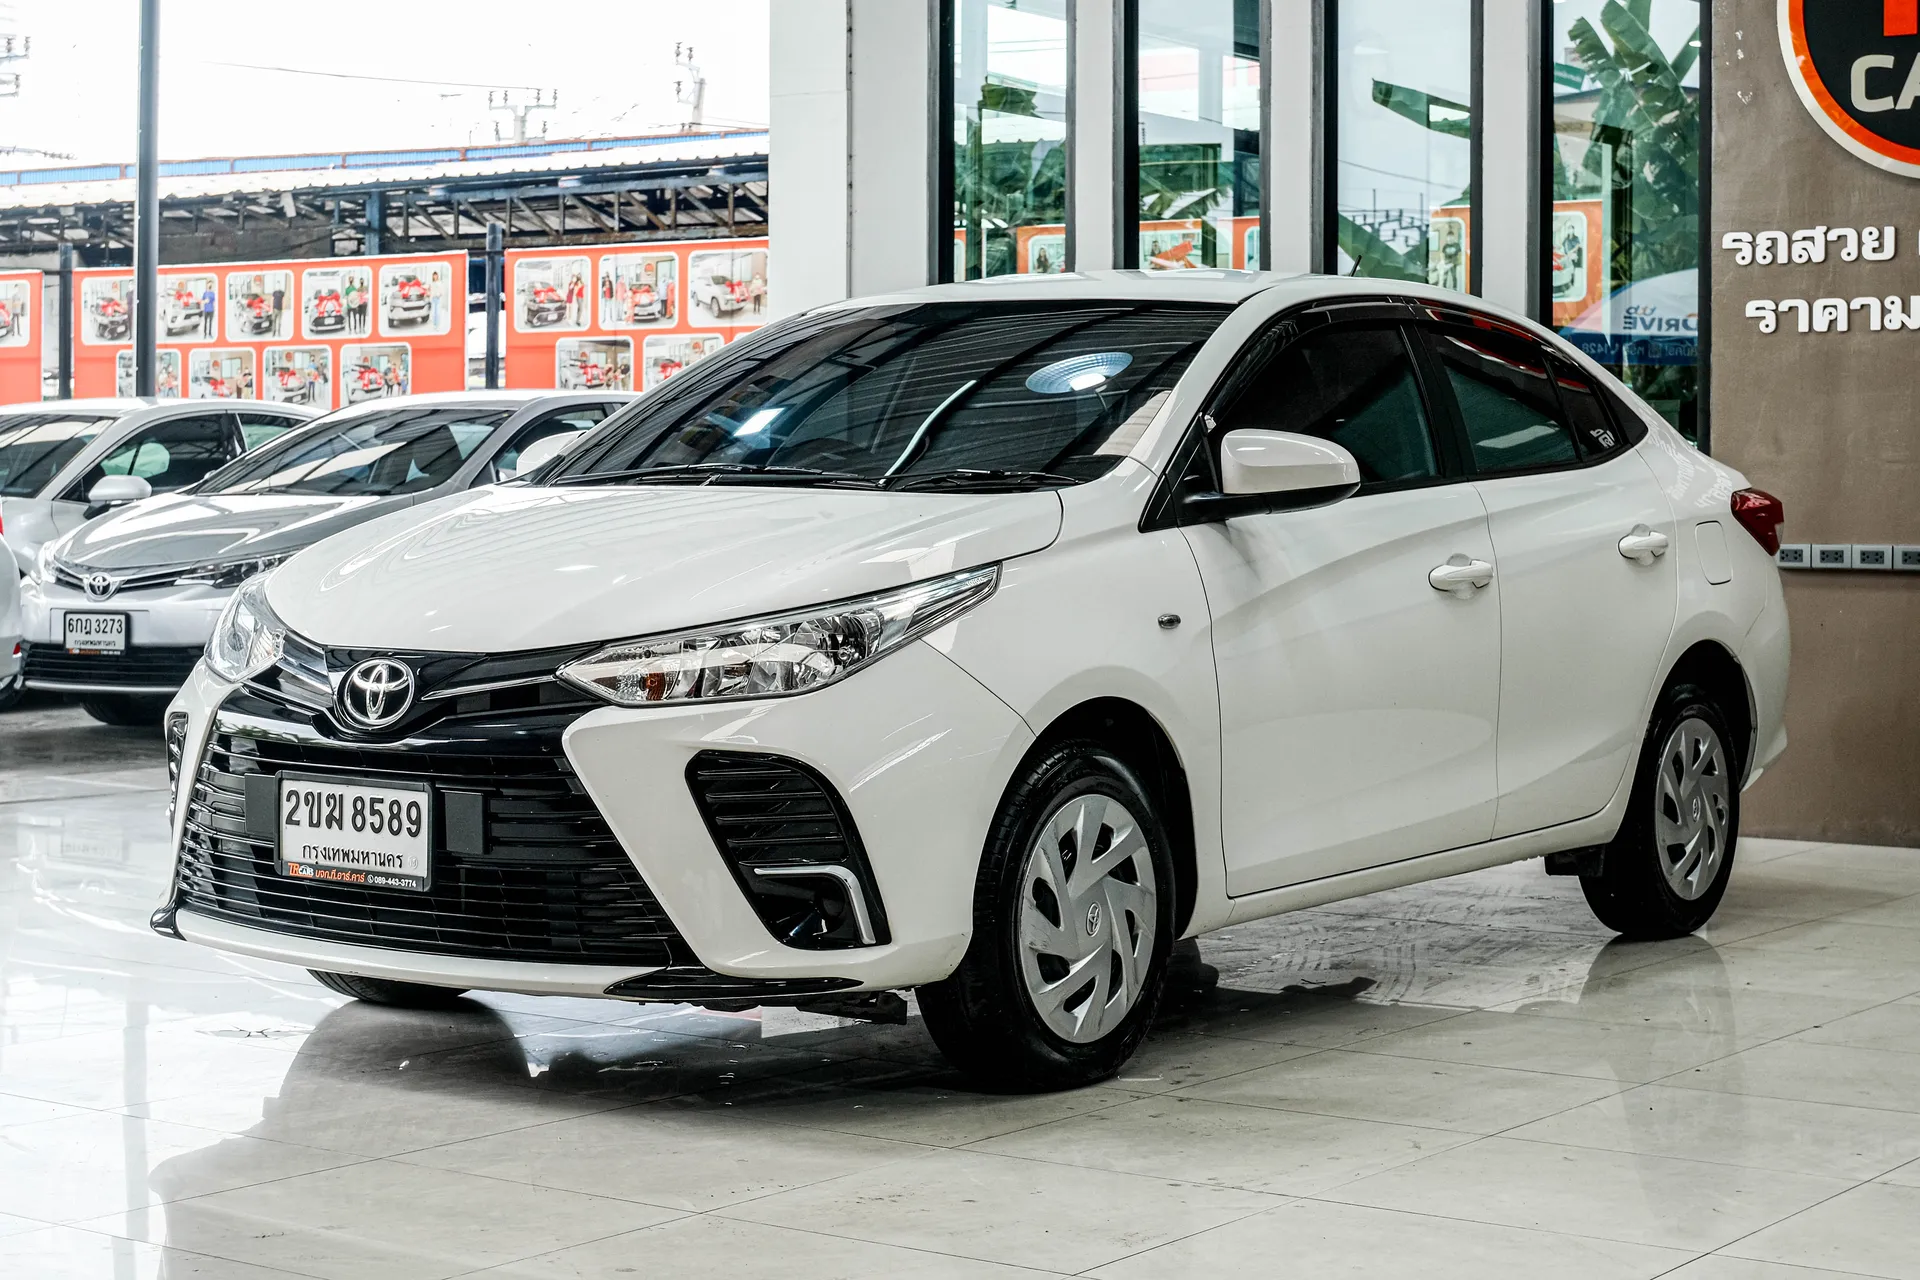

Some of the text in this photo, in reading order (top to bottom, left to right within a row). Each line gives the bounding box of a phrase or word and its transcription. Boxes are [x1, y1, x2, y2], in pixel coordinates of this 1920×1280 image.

[1722, 225, 1896, 266] รถสวย
[94, 618, 123, 634] 3273
[285, 789, 422, 838] 2ขฆ 8589
[302, 844, 404, 869] กรุงเทพมหานคร
[374, 875, 417, 888] 089-443-3774
